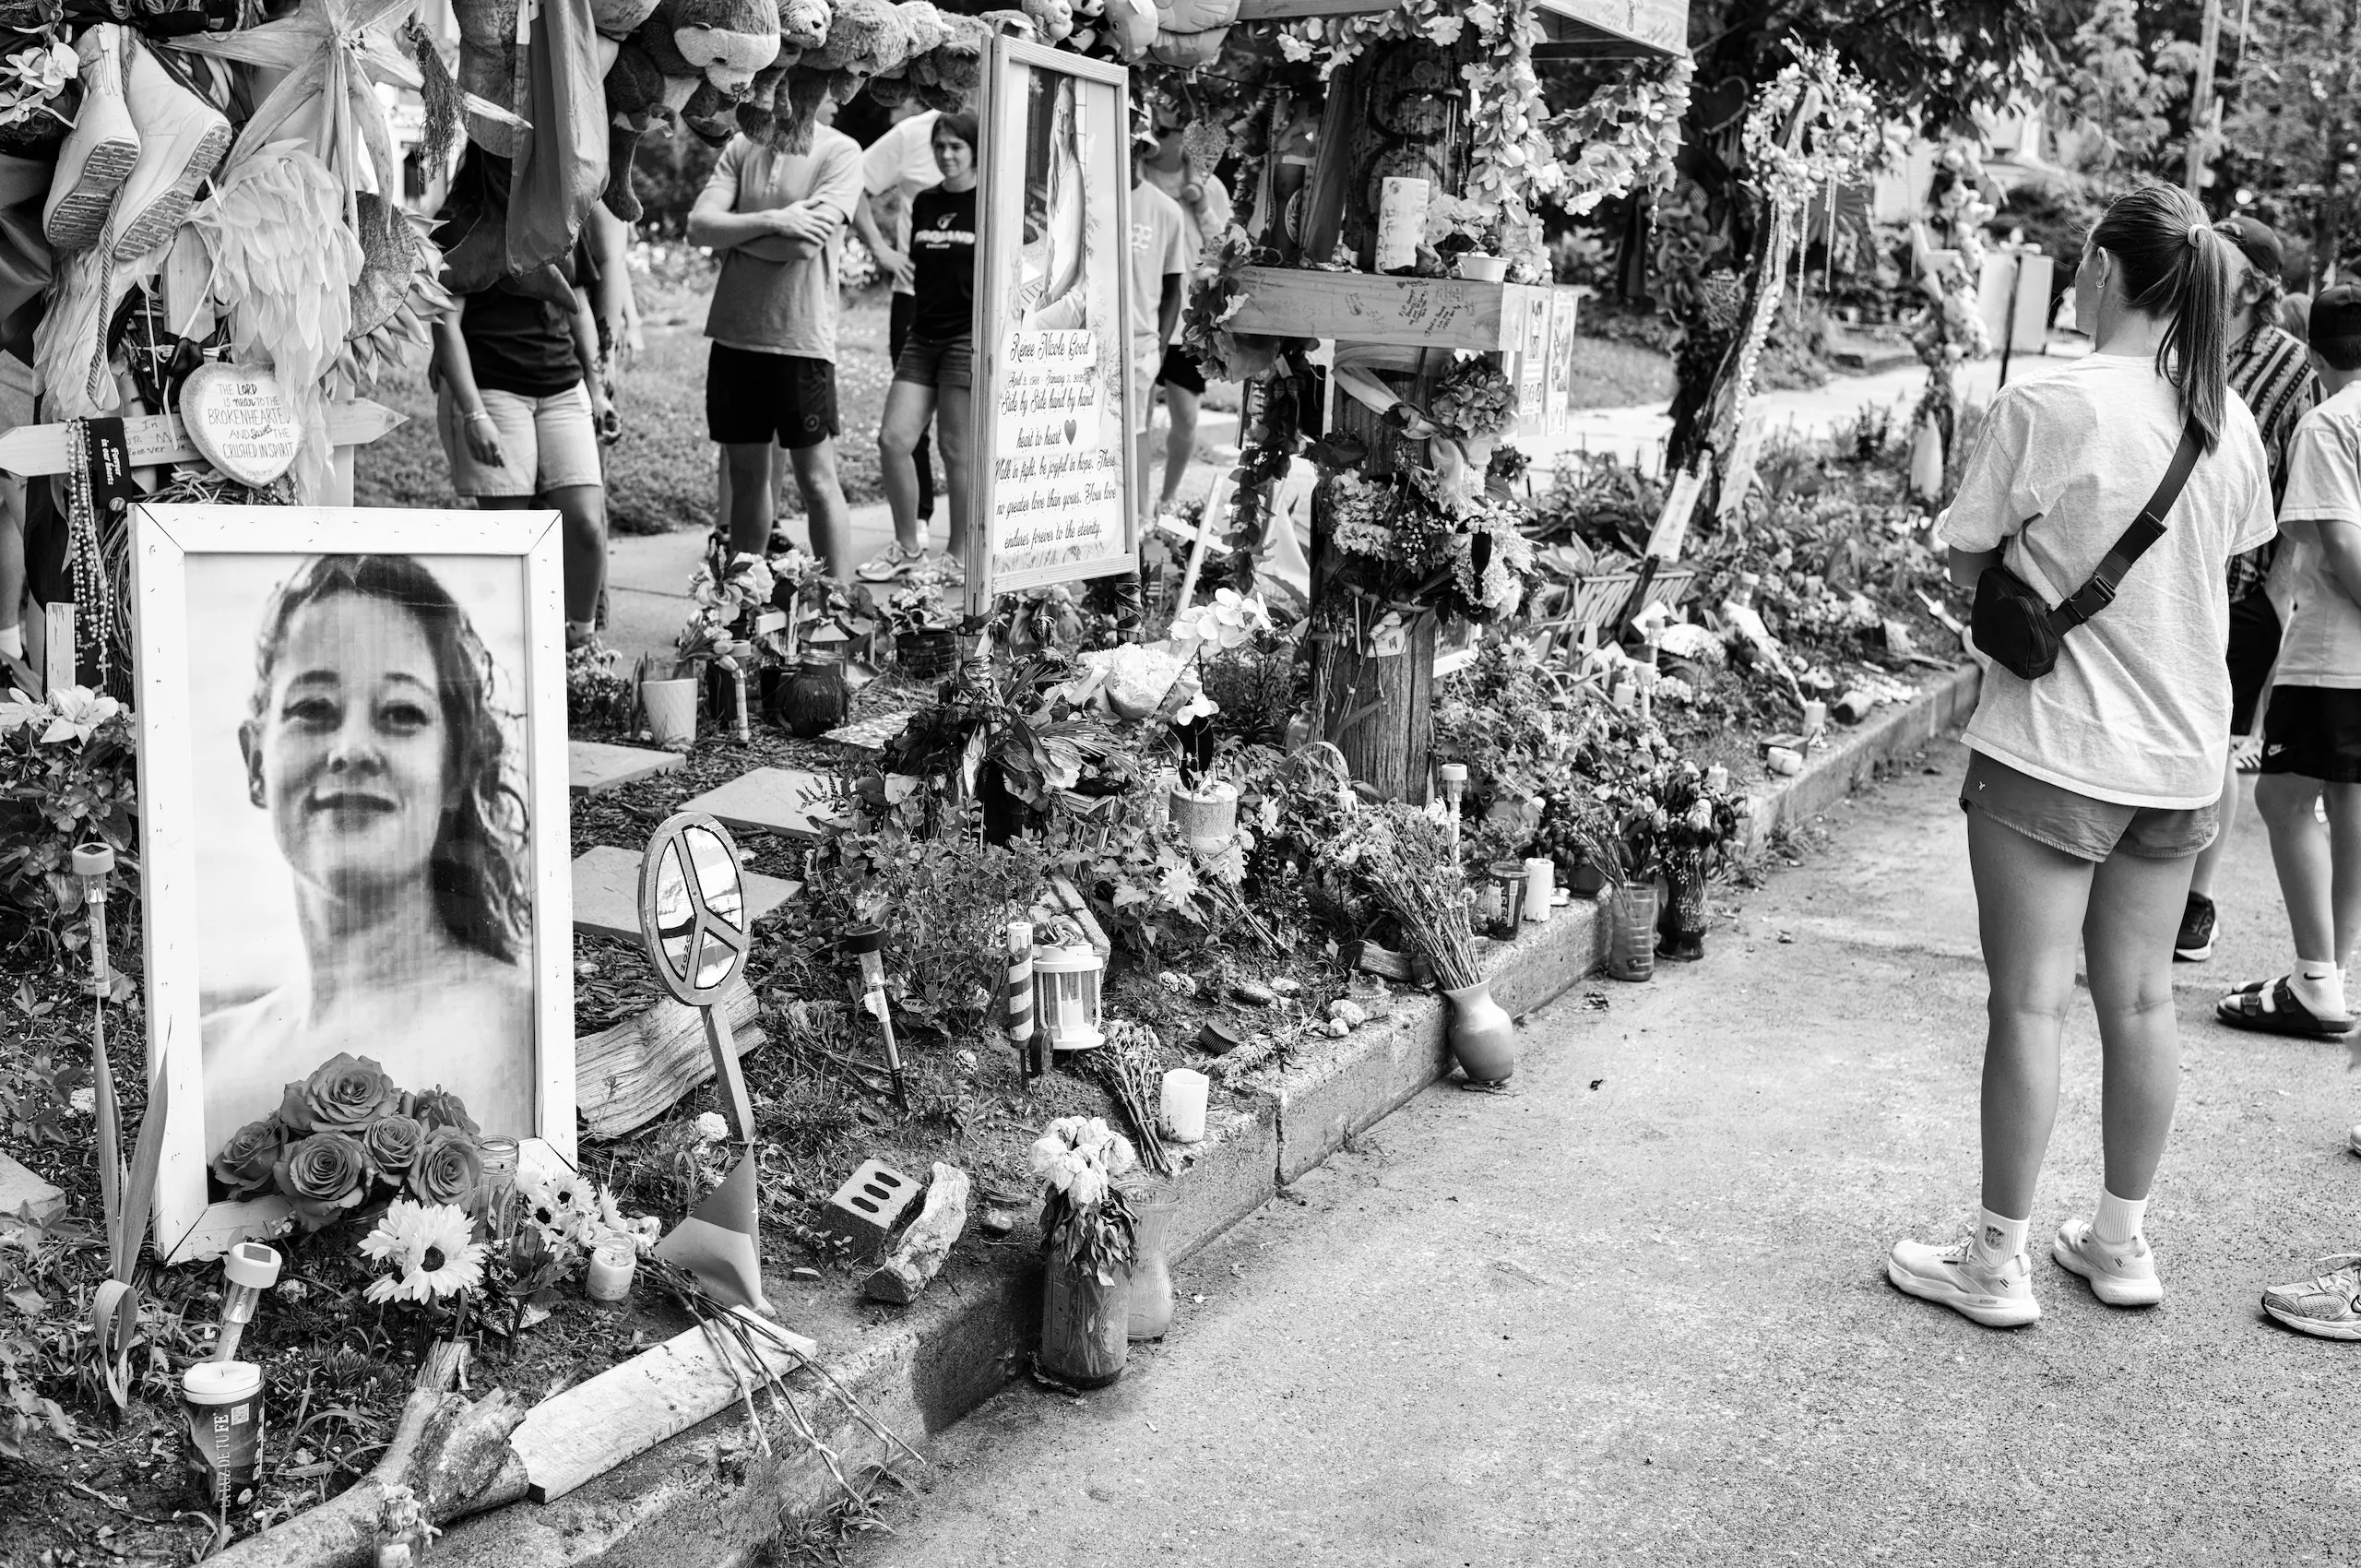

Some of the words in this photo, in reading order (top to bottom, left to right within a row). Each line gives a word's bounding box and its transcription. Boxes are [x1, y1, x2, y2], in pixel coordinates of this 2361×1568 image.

[1010, 333, 1035, 362] Renee
[1038, 333, 1064, 360] Nicole
[1068, 332, 1091, 361] Good
[218, 384, 233, 395] THE
[236, 383, 257, 396] LORD
[223, 398, 231, 408] IS
[232, 398, 255, 408] near
[255, 398, 266, 407] TO
[266, 397, 279, 406] THE
[1002, 390, 1017, 415] Side
[1019, 390, 1028, 417] by
[1031, 388, 1047, 412] Side
[1049, 387, 1067, 409] hand
[1067, 387, 1075, 413] by
[1077, 387, 1095, 407] hand
[101, 438, 110, 447] in
[230, 429, 250, 440] AND
[273, 429, 291, 440] THE
[1016, 427, 1034, 448] heart
[1035, 430, 1043, 446] to
[1044, 424, 1062, 445] heart
[102, 447, 111, 461] our
[222, 443, 257, 459] CRUSHED
[259, 443, 268, 457] IN
[268, 442, 294, 458] SPIRIT
[111, 447, 122, 477] Forever
[1013, 464, 1019, 478] in
[1039, 456, 1047, 475] be
[1047, 453, 1070, 480] joyful
[1070, 457, 1075, 471] in
[1077, 452, 1094, 473] hope.
[1097, 449, 1116, 470] There
[105, 461, 114, 486] hearts
[996, 504, 1005, 516] no
[1006, 496, 1028, 519] greater
[1031, 491, 1045, 510] love
[1047, 488, 1062, 508] than
[1062, 492, 1082, 511] yours.
[1085, 482, 1102, 505] Your
[1104, 481, 1117, 499] love
[1004, 528, 1029, 549] endures
[1031, 528, 1053, 550] forever
[1056, 524, 1063, 540] to
[1065, 519, 1075, 539] the
[1077, 517, 1102, 539] eternity.
[214, 1414, 230, 1433] FE
[216, 1434, 230, 1450] TU
[217, 1452, 231, 1467] DE
[219, 1470, 231, 1493] LUZ
